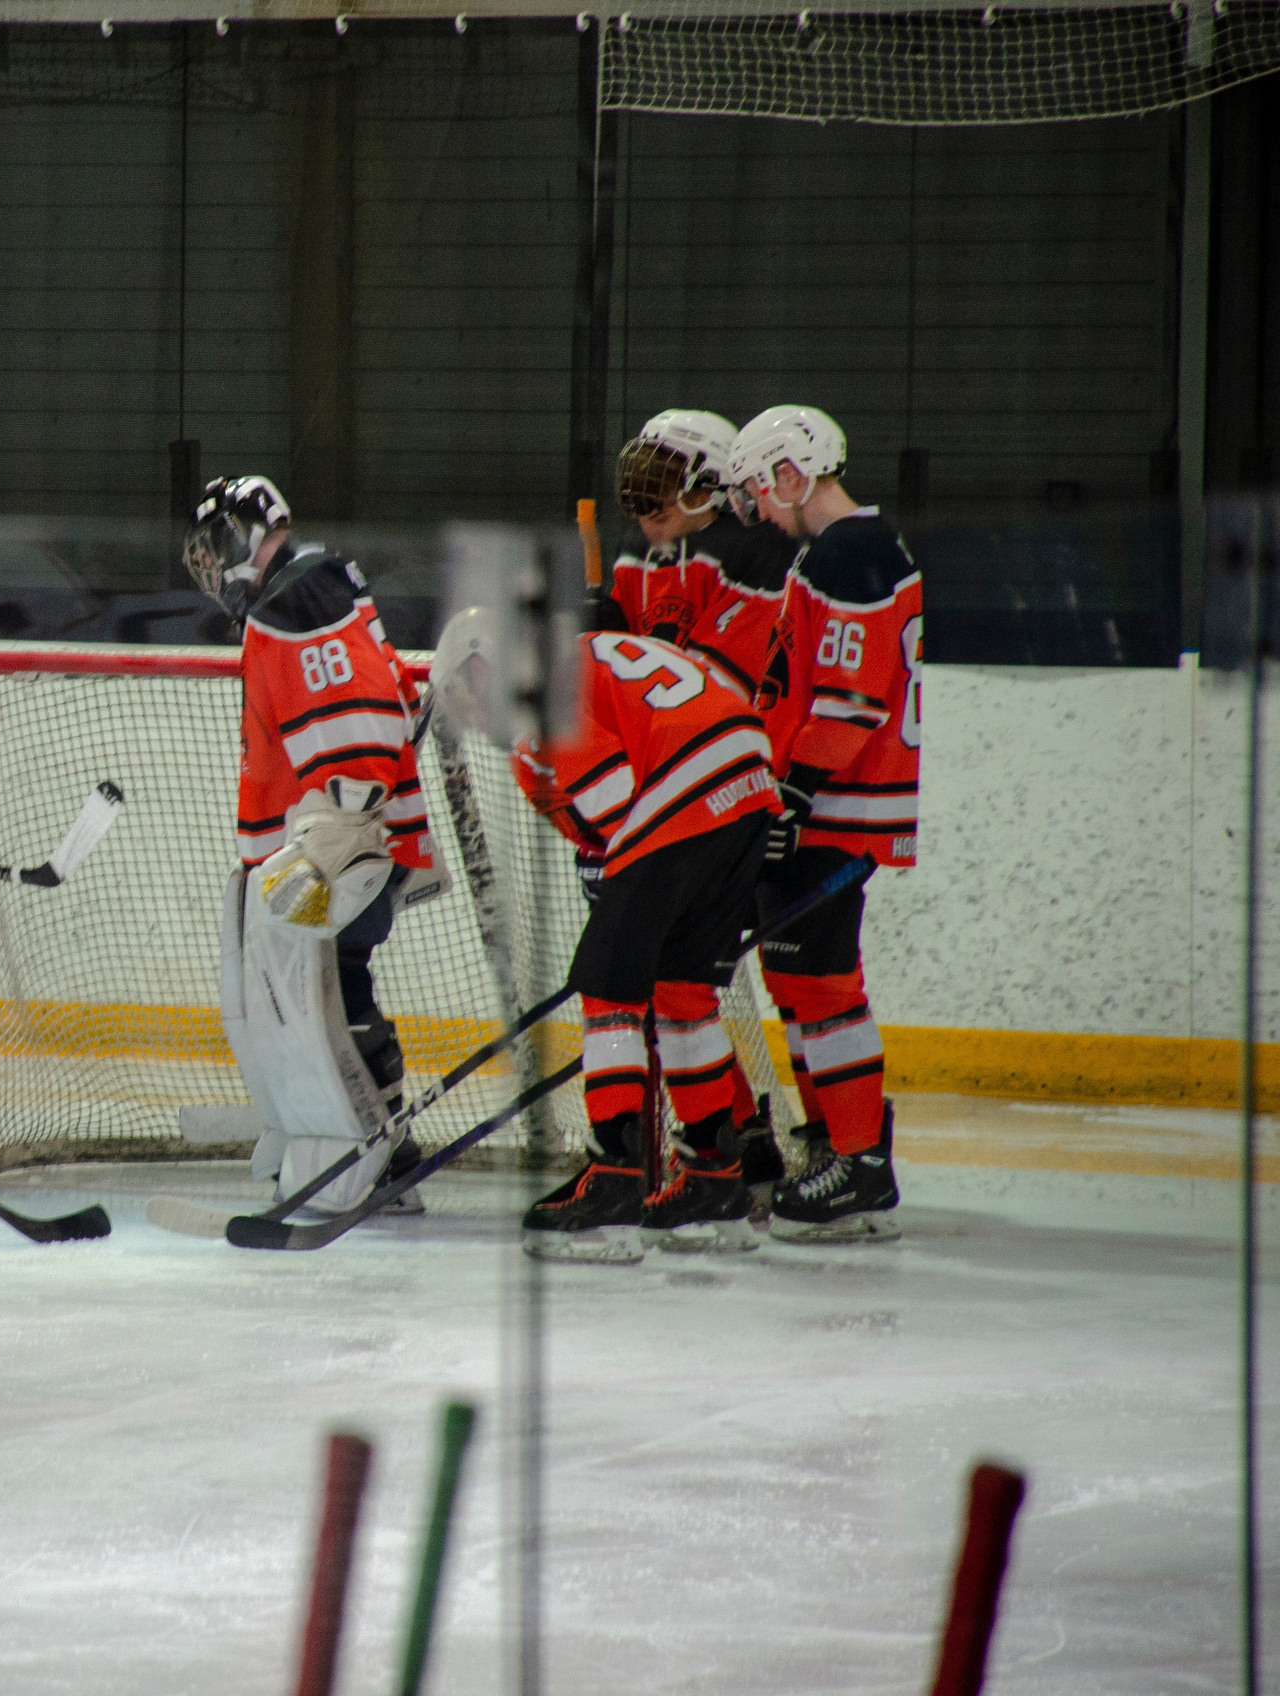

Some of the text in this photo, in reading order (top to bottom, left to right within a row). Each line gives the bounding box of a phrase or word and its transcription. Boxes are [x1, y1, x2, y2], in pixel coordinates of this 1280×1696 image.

[299, 638, 354, 693] 88
[590, 632, 706, 711] 9
[816, 618, 866, 671] 86
